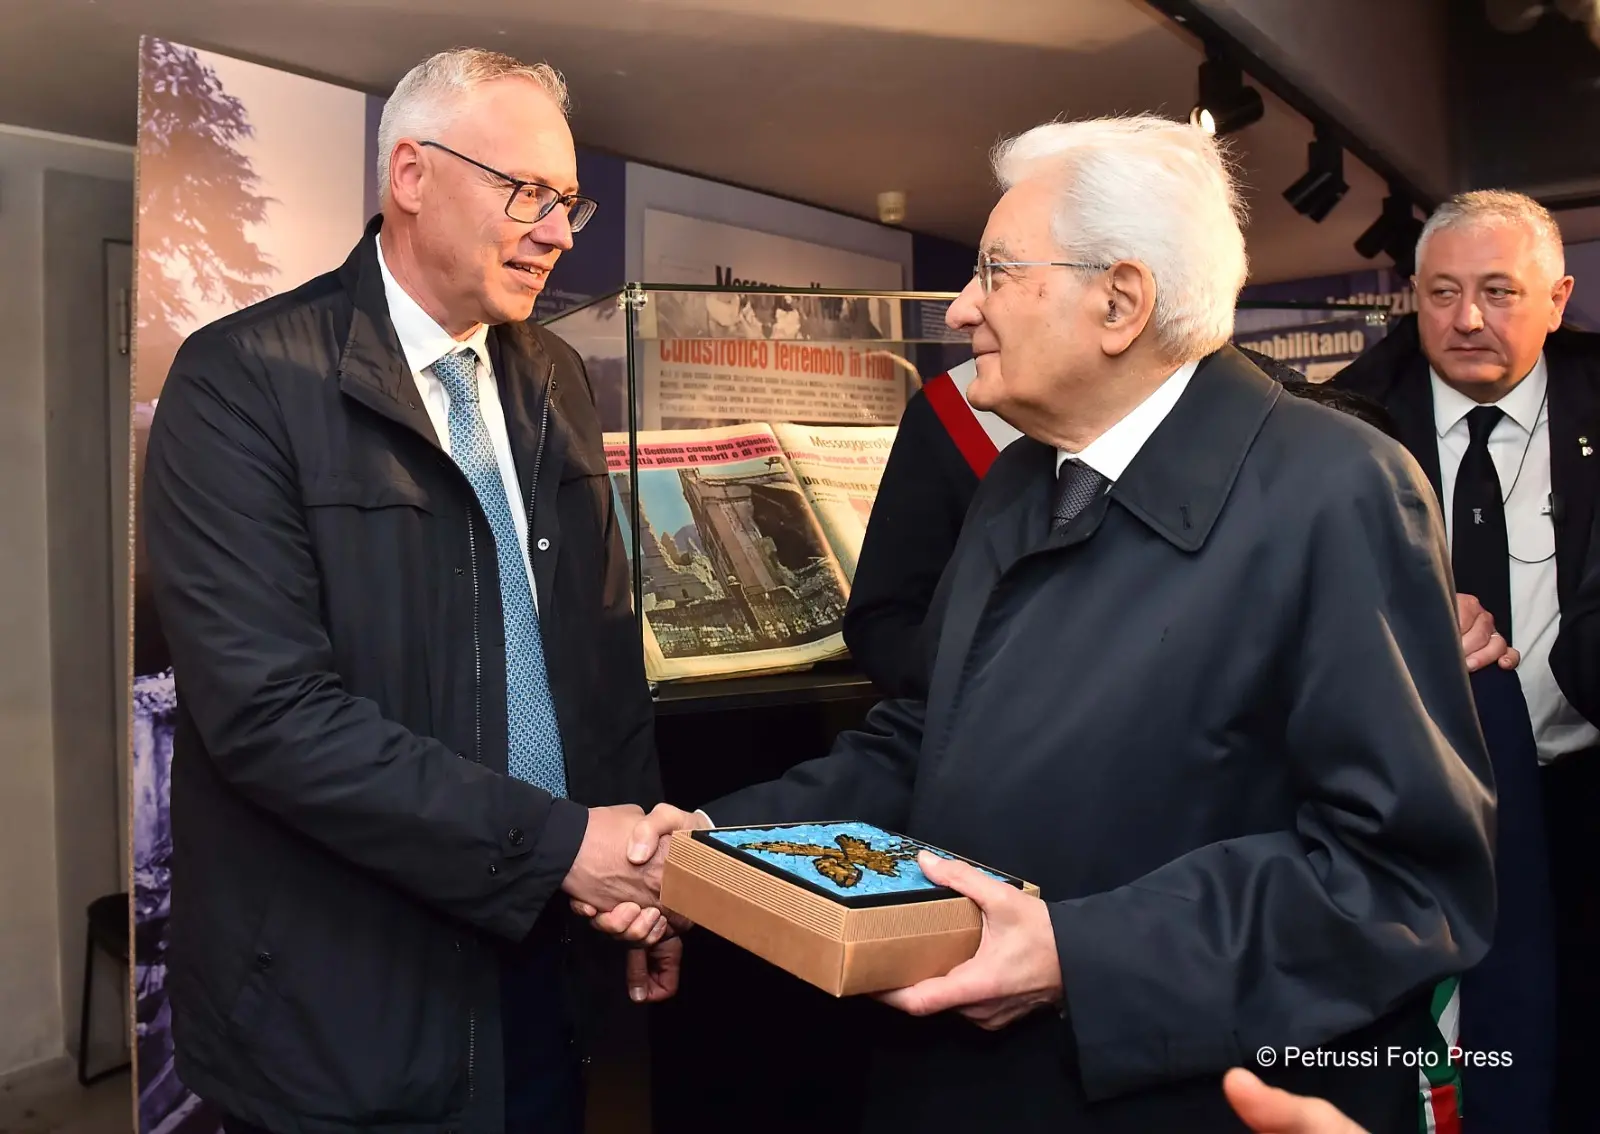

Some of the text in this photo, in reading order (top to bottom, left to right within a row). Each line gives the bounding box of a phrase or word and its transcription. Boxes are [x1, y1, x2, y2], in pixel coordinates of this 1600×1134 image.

[848, 346, 861, 377] in
[625, 456, 654, 467] cttà
[687, 453, 699, 463] di
[701, 451, 729, 461] morti
[742, 447, 753, 457] di
[644, 446, 685, 456] Gemona
[686, 445, 713, 454] come
[802, 476, 820, 485] Un
